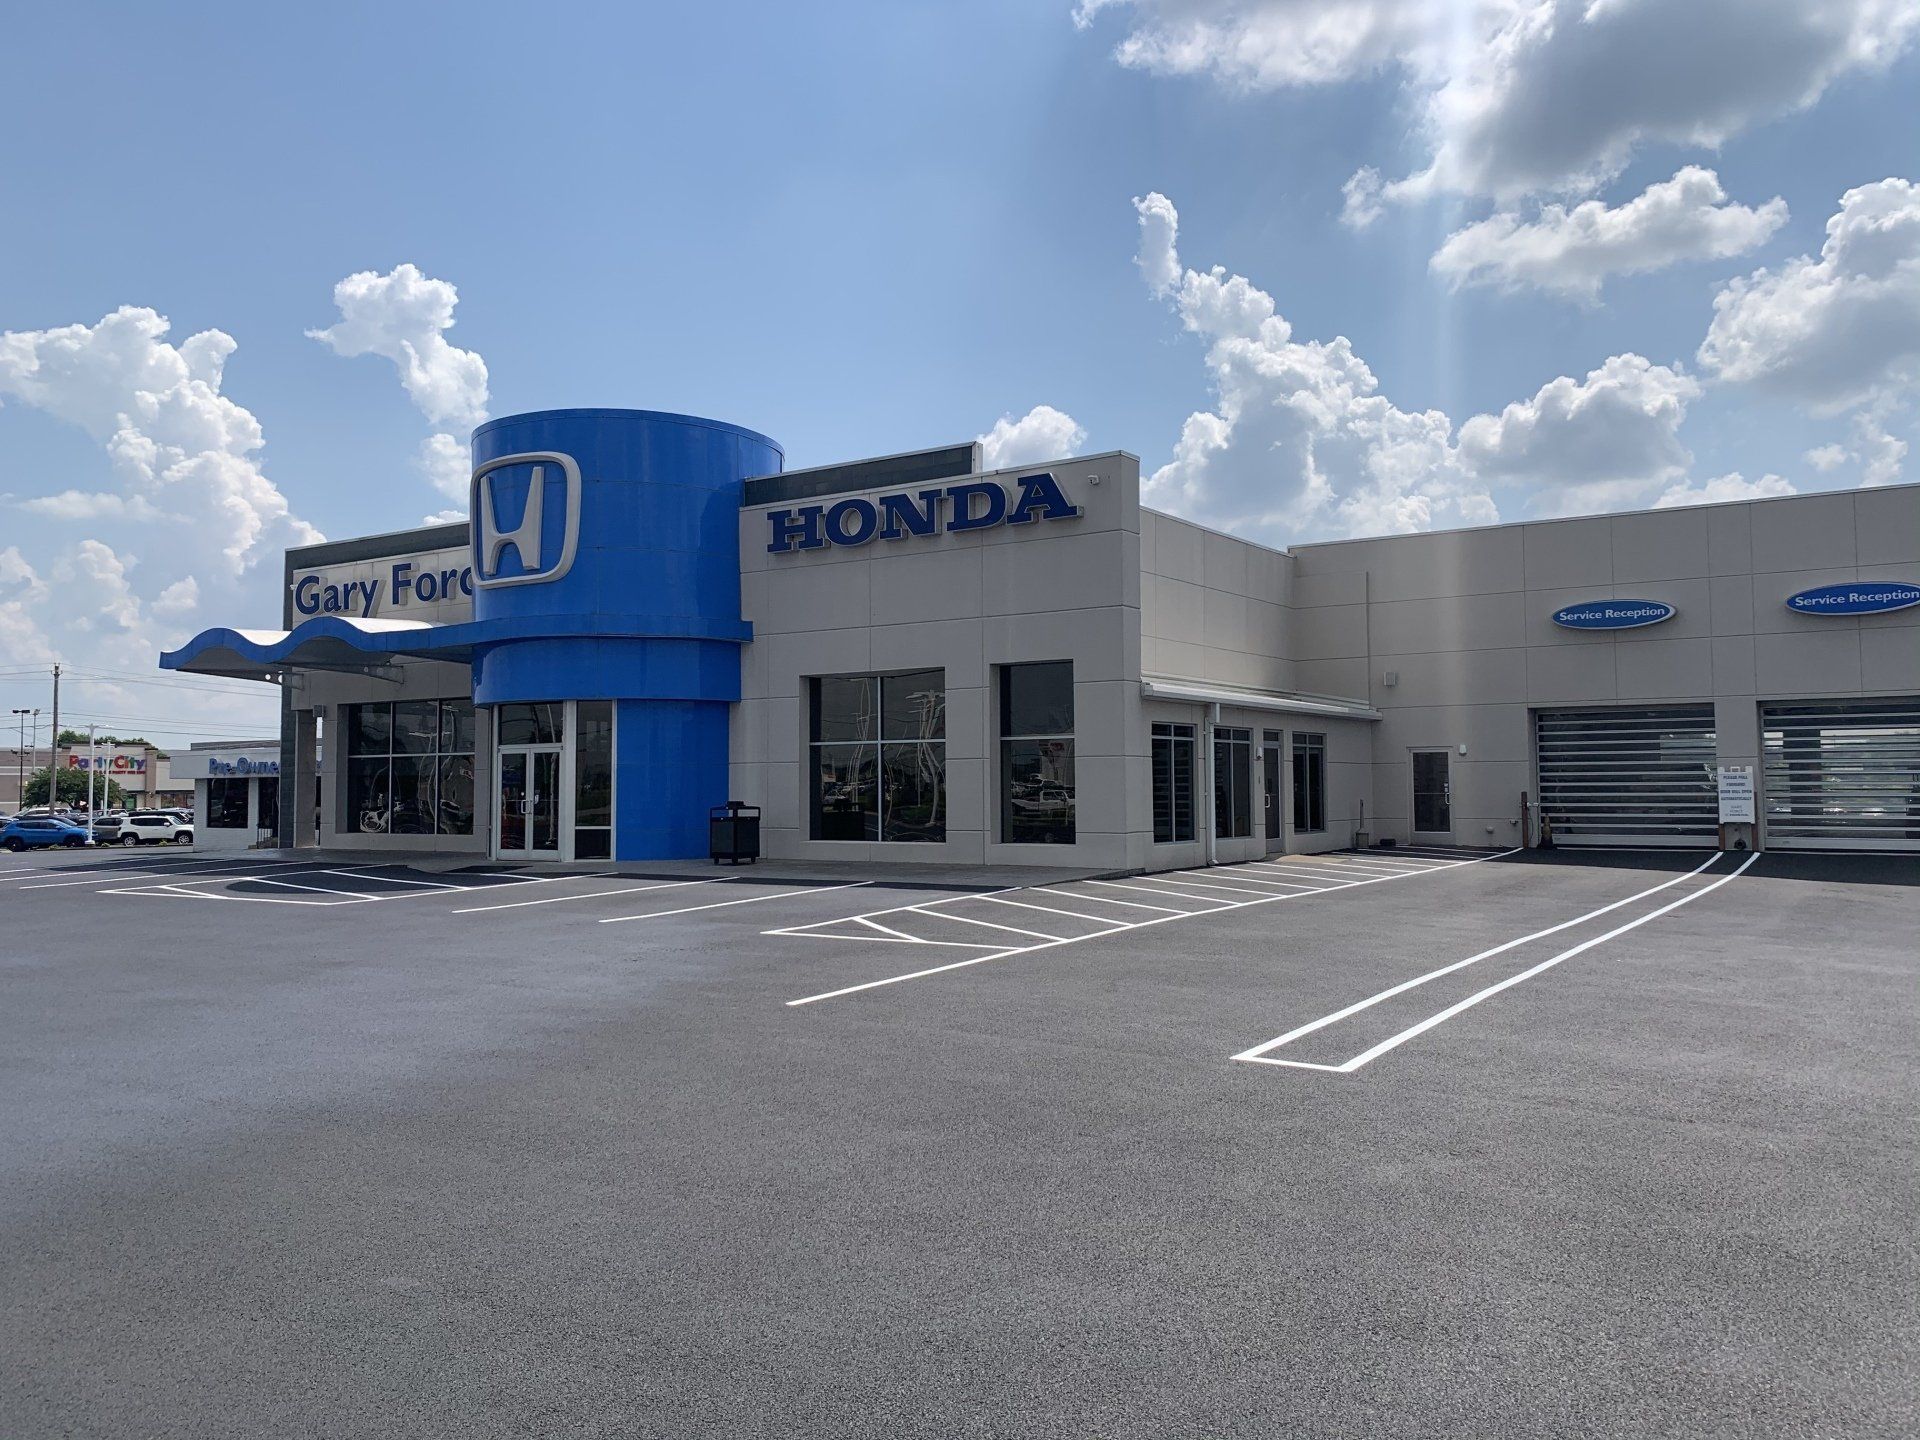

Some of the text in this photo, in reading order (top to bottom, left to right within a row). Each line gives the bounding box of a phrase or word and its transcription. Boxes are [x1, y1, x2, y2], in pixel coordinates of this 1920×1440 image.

[766, 472, 1084, 554] HONDA
[295, 574, 380, 619] Gary
[1794, 589, 1920, 607] Service Reception
[1559, 606, 1666, 621] Service Reception
[114, 754, 147, 771] City
[208, 757, 280, 775] Pre-Owne
